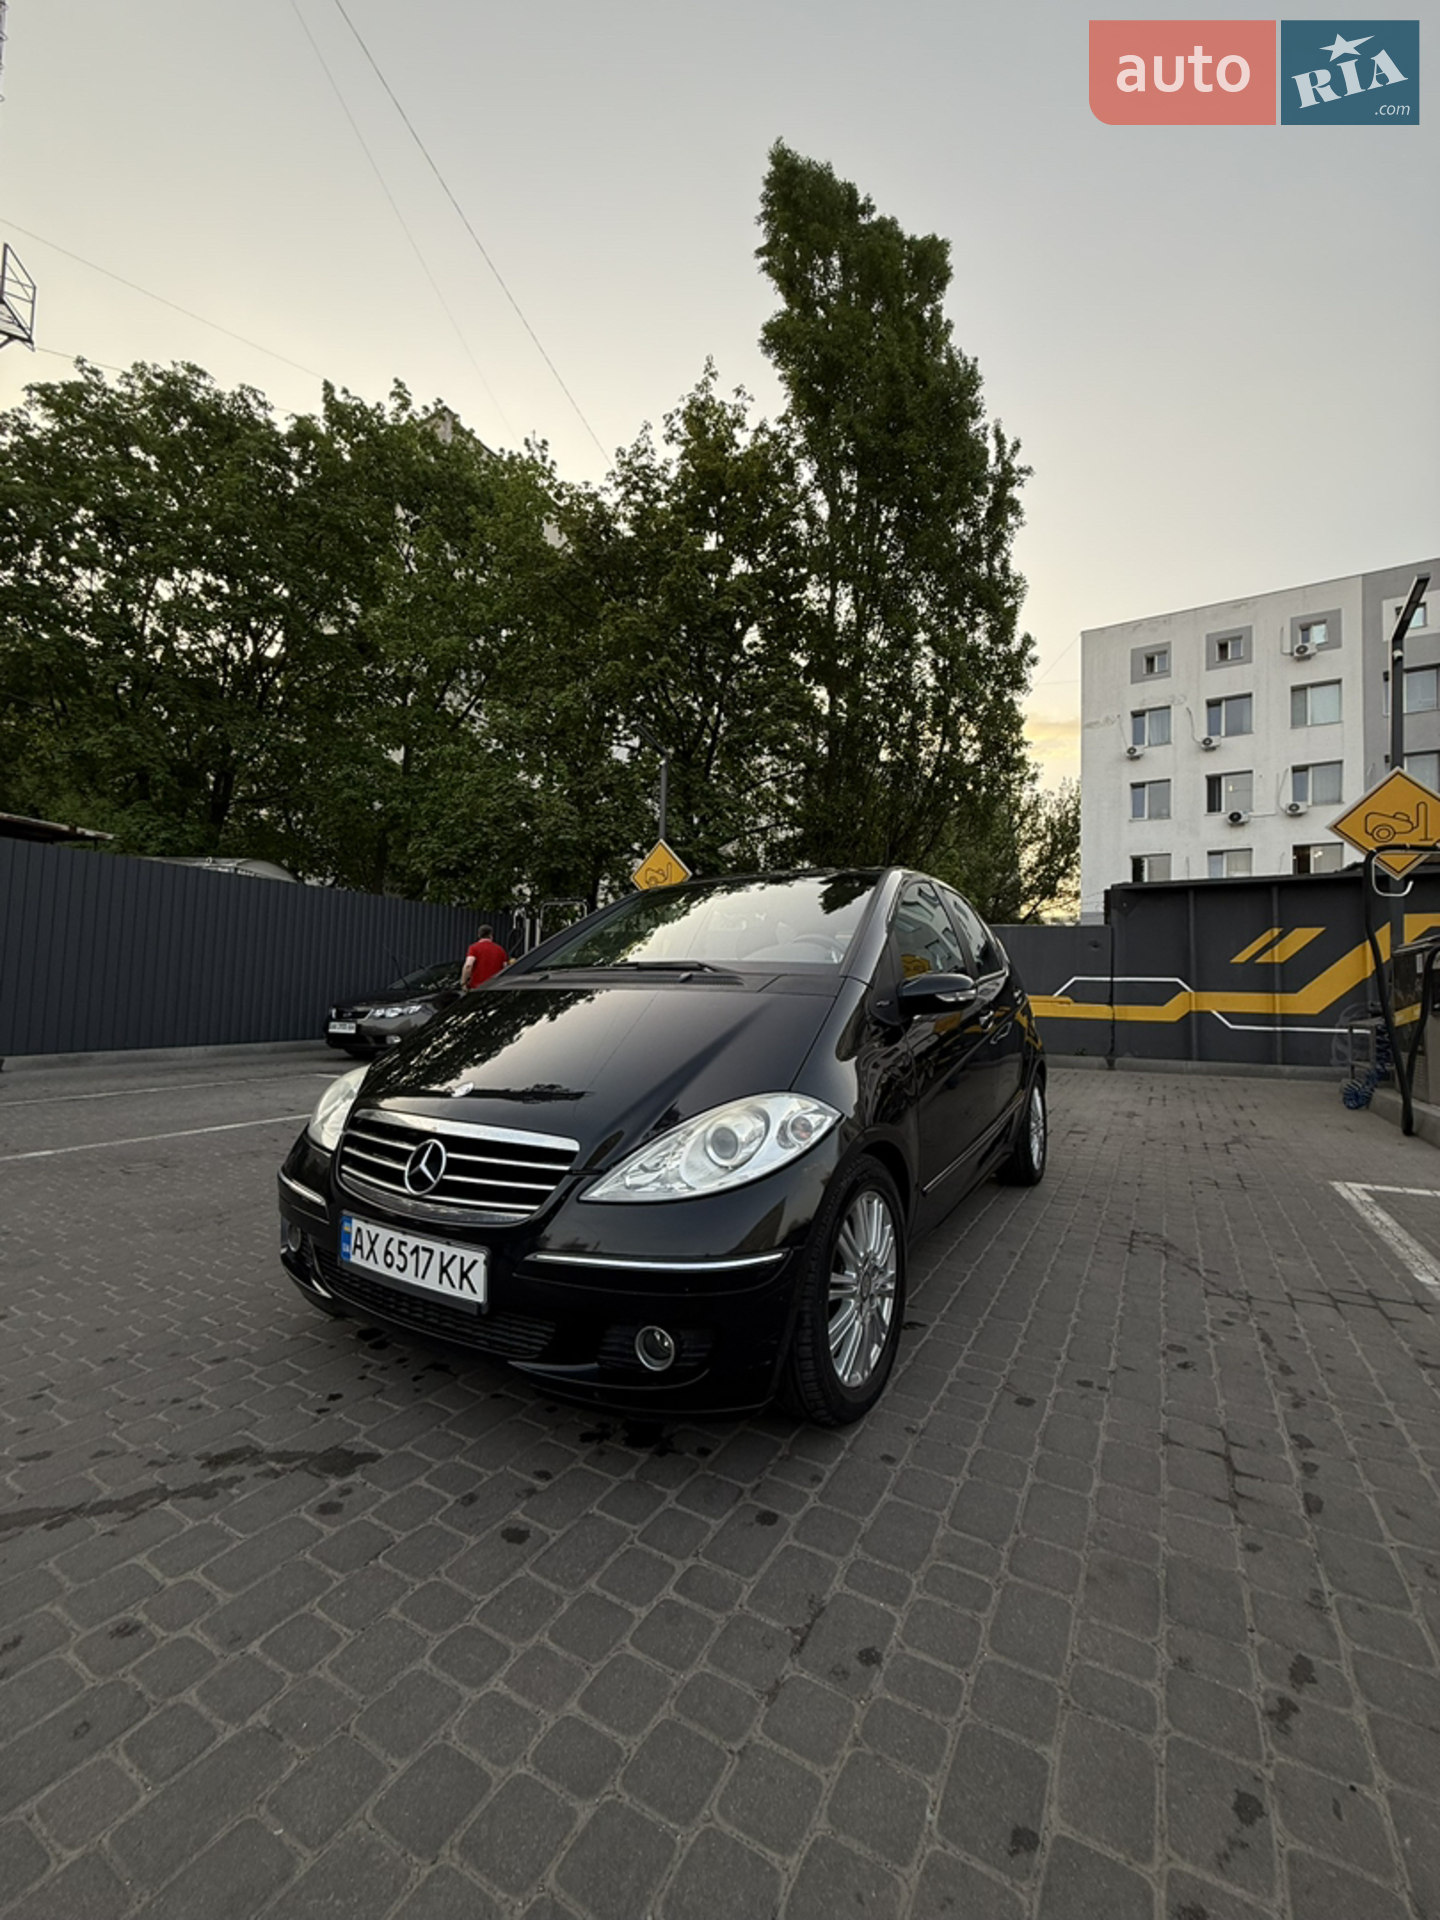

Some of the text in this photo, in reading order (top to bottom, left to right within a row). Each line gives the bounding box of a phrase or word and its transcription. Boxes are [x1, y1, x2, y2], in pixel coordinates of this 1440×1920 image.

[352, 1226, 479, 1295] AX 6517 KK
